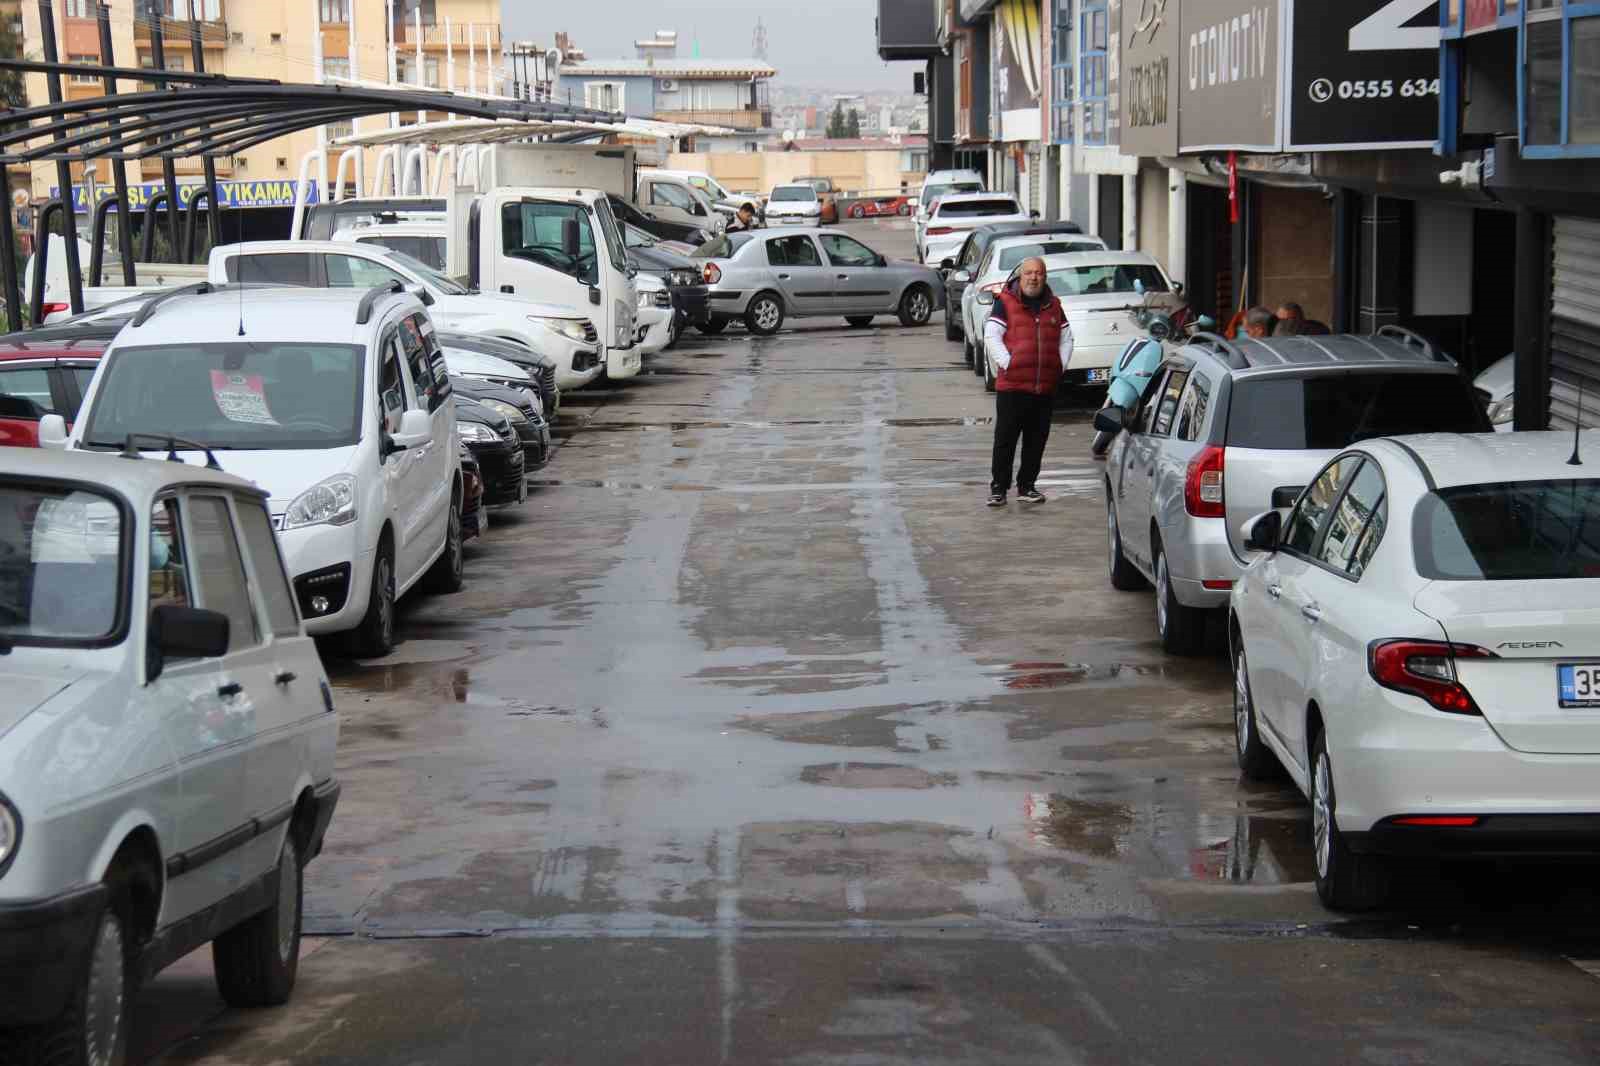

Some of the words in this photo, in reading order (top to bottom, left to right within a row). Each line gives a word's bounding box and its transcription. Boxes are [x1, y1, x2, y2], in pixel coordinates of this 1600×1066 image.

[1189, 7, 1269, 91] OTOMOTİV
[1338, 80, 1393, 99] 0555
[222, 182, 293, 202] YIKAMA
